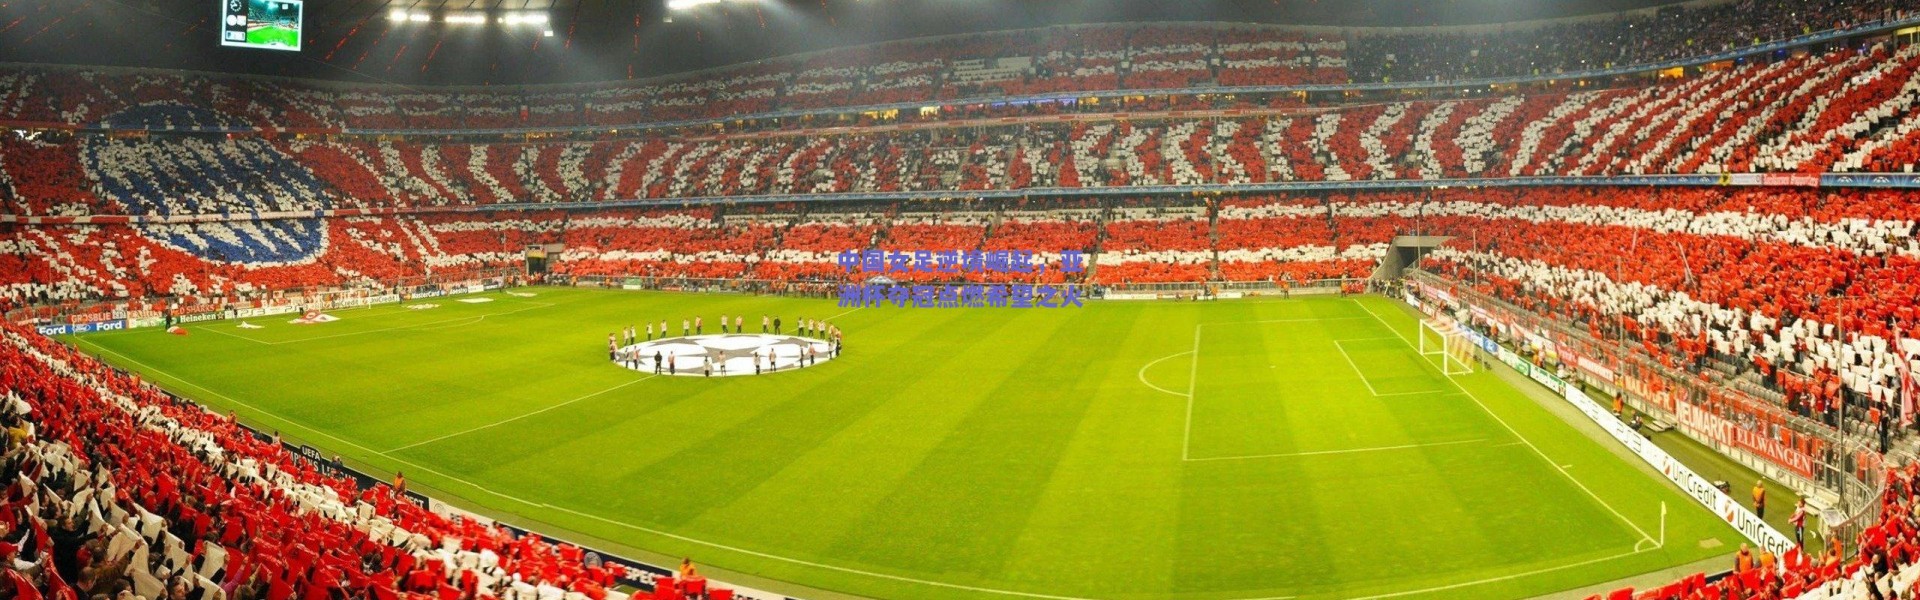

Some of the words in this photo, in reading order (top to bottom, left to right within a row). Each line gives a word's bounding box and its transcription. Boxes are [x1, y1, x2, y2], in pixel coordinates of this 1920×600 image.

[96, 320, 122, 331] Ford
[180, 313, 216, 323] Heineken
[39, 326, 66, 336] Ford
[1676, 399, 1733, 447] NEUMARKT
[301, 446, 321, 461] UEFA
[1736, 428, 1812, 475] ELLWANGEN
[1672, 461, 1718, 511] UniCredit
